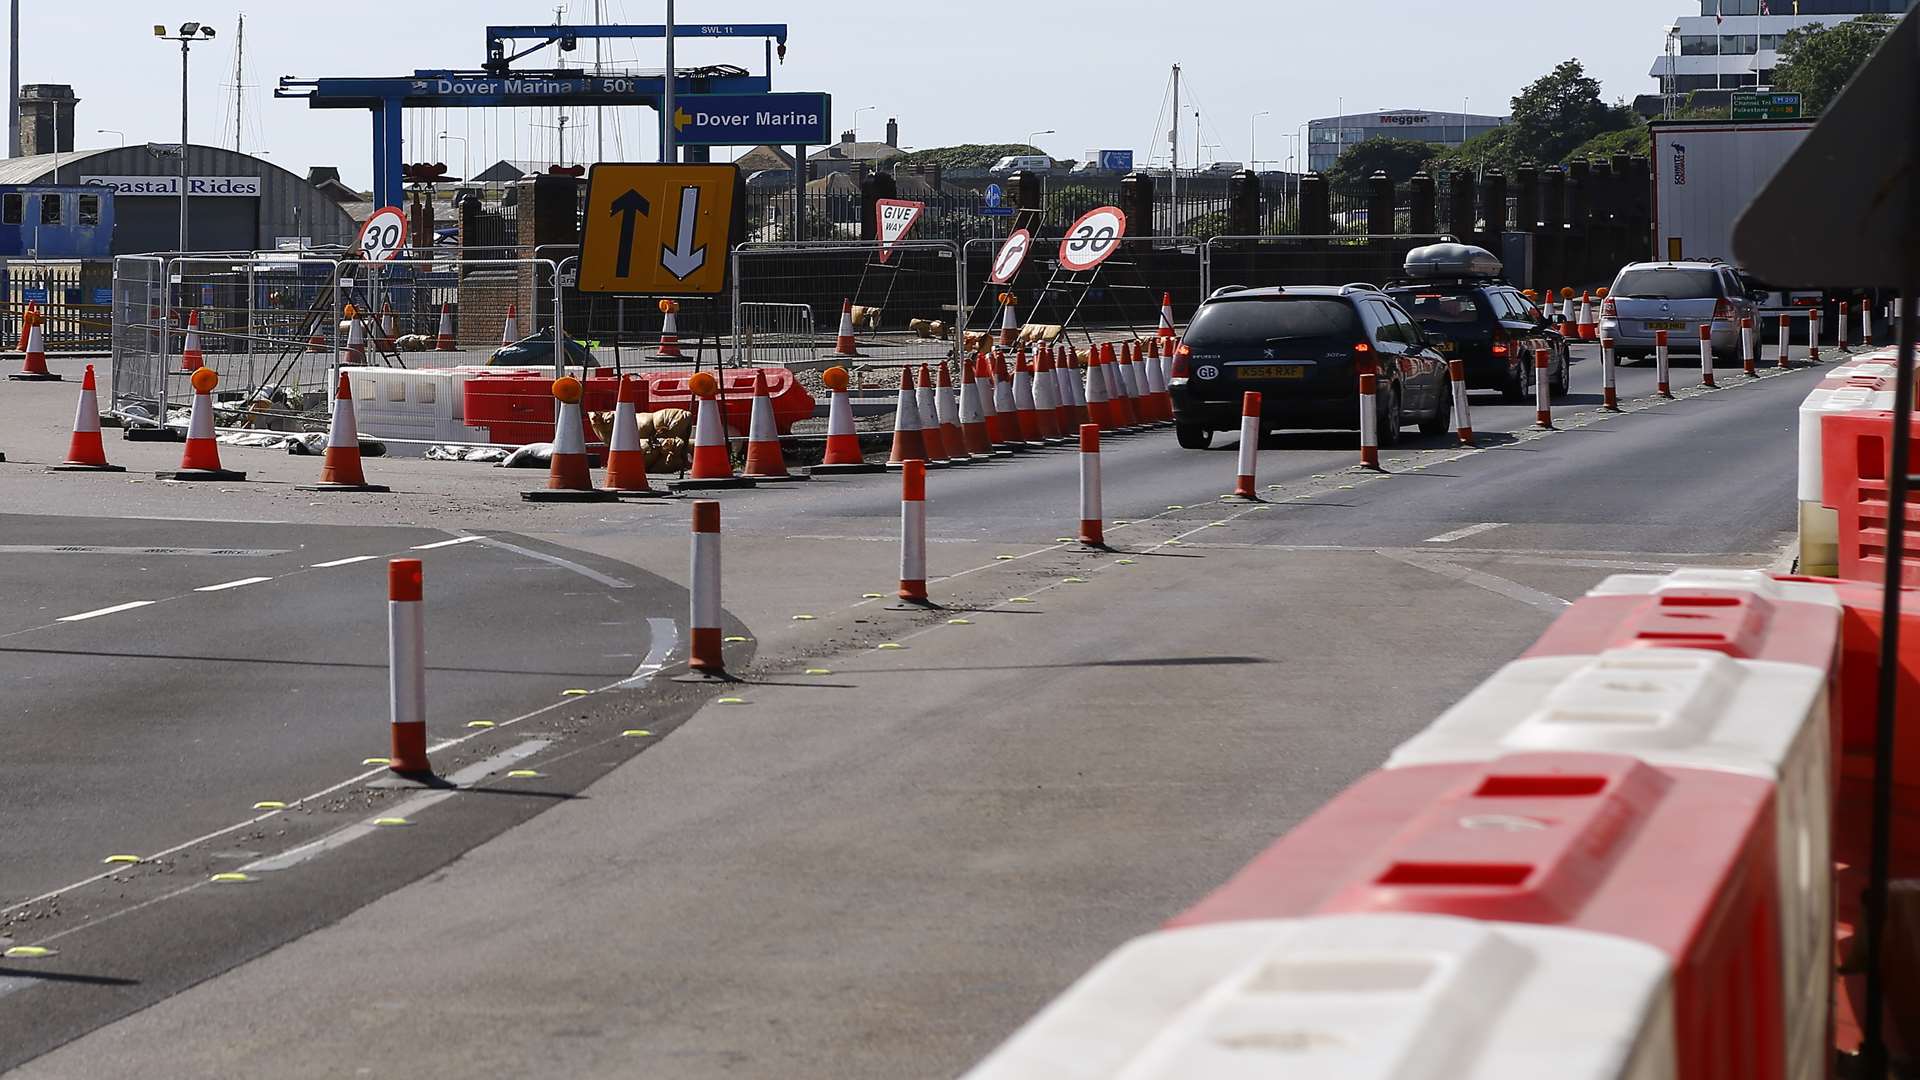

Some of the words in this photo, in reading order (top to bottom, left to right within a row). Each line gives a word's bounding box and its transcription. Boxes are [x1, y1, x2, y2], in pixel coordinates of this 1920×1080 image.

[701, 26, 721, 34] SWL
[724, 26, 734, 34] 1t
[438, 79, 498, 95] Dover
[504, 78, 572, 94] Marina
[603, 79, 635, 93] 50t
[696, 112, 750, 127] Dover
[755, 111, 818, 126] Marina
[189, 179, 257, 194] Rides
[884, 206, 911, 221] GIVE
[885, 222, 904, 232] WAY
[364, 224, 399, 250] 30
[1070, 225, 1115, 253] 30
[1200, 367, 1217, 378] GB
